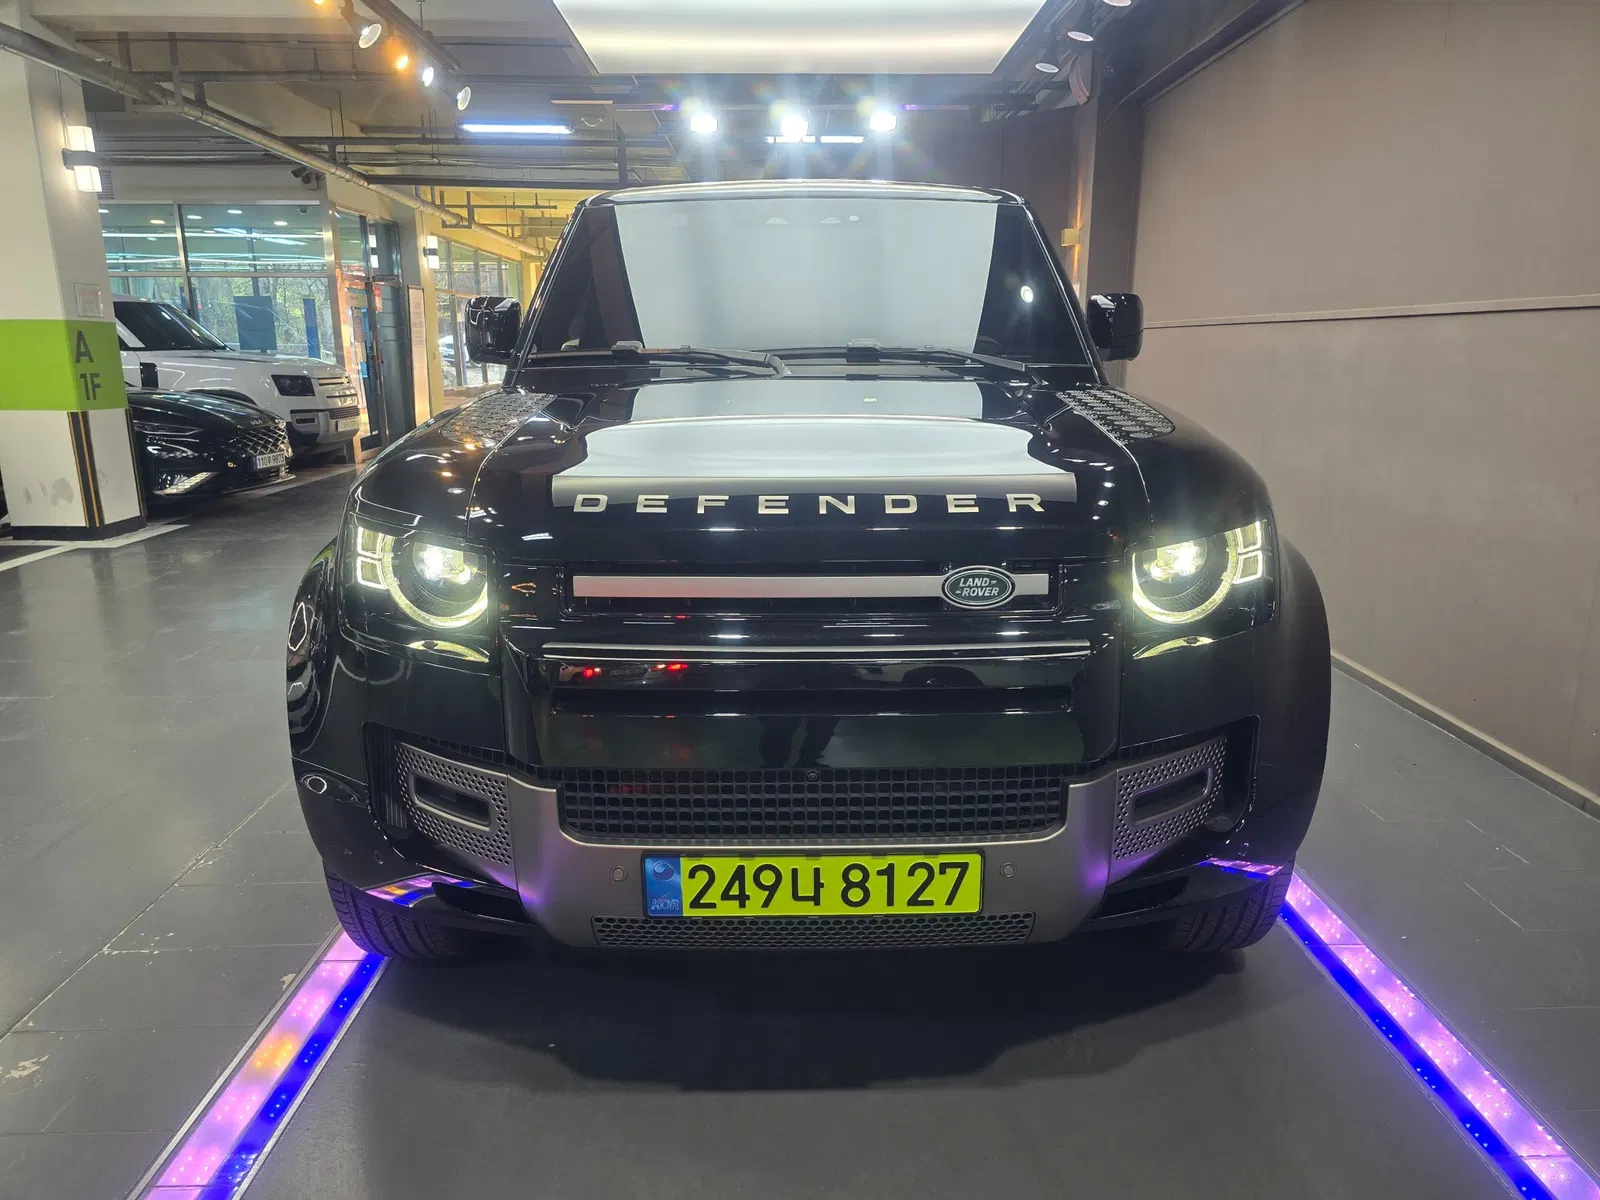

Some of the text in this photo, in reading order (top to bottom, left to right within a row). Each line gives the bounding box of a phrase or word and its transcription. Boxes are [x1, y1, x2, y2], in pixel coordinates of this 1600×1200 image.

[75, 330, 95, 364] A
[80, 372, 102, 401] 1F
[573, 493, 1045, 515] DEFENDER
[688, 861, 970, 909] 249나 8127
[651, 898, 680, 910] KOR
